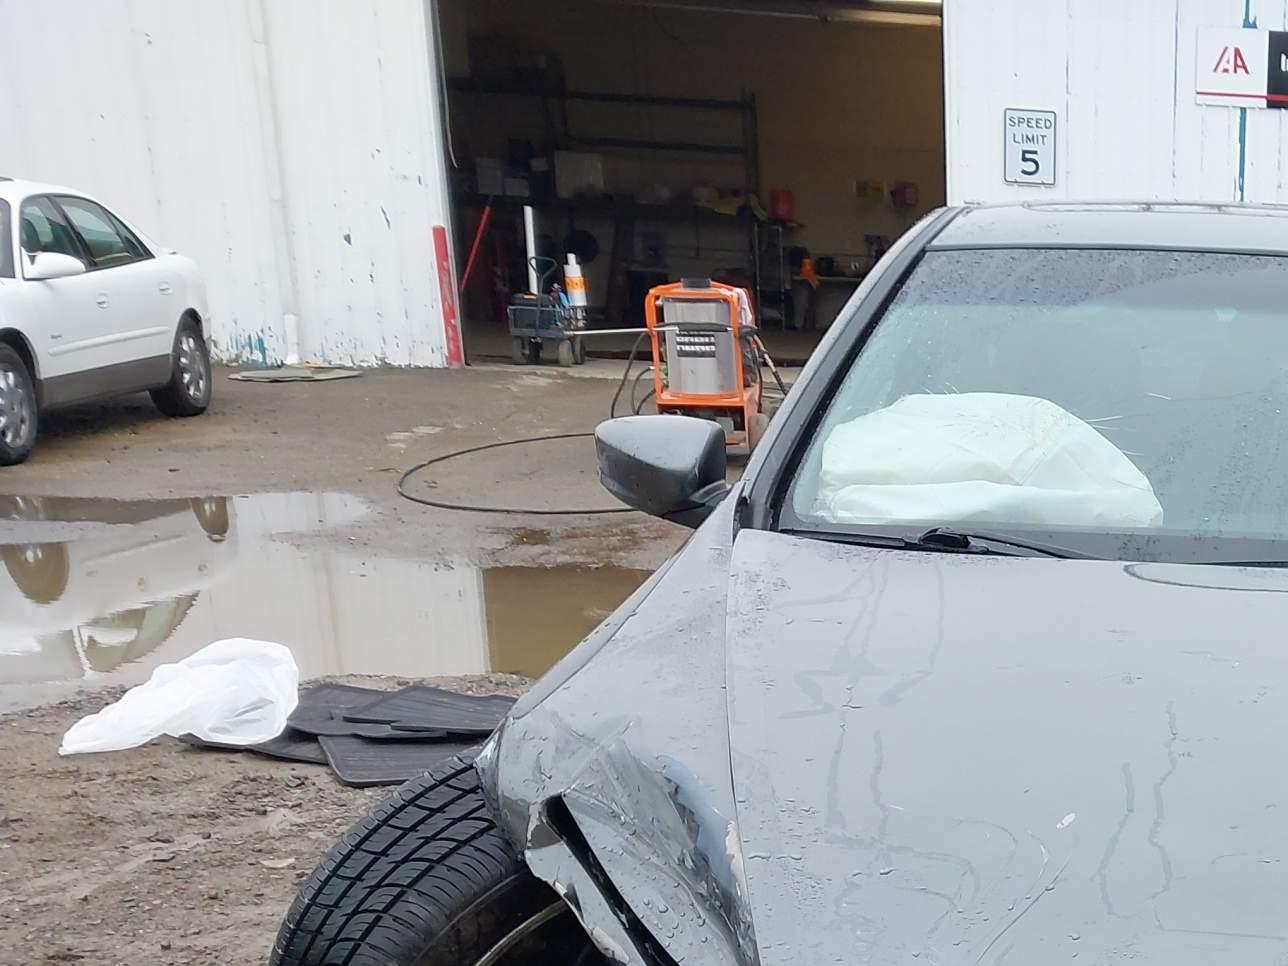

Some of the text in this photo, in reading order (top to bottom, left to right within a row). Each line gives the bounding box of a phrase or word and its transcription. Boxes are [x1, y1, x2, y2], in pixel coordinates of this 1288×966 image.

[1008, 116, 1052, 129] SPEED
[1012, 133, 1047, 145] LIMIT
[1021, 149, 1039, 176] 5
